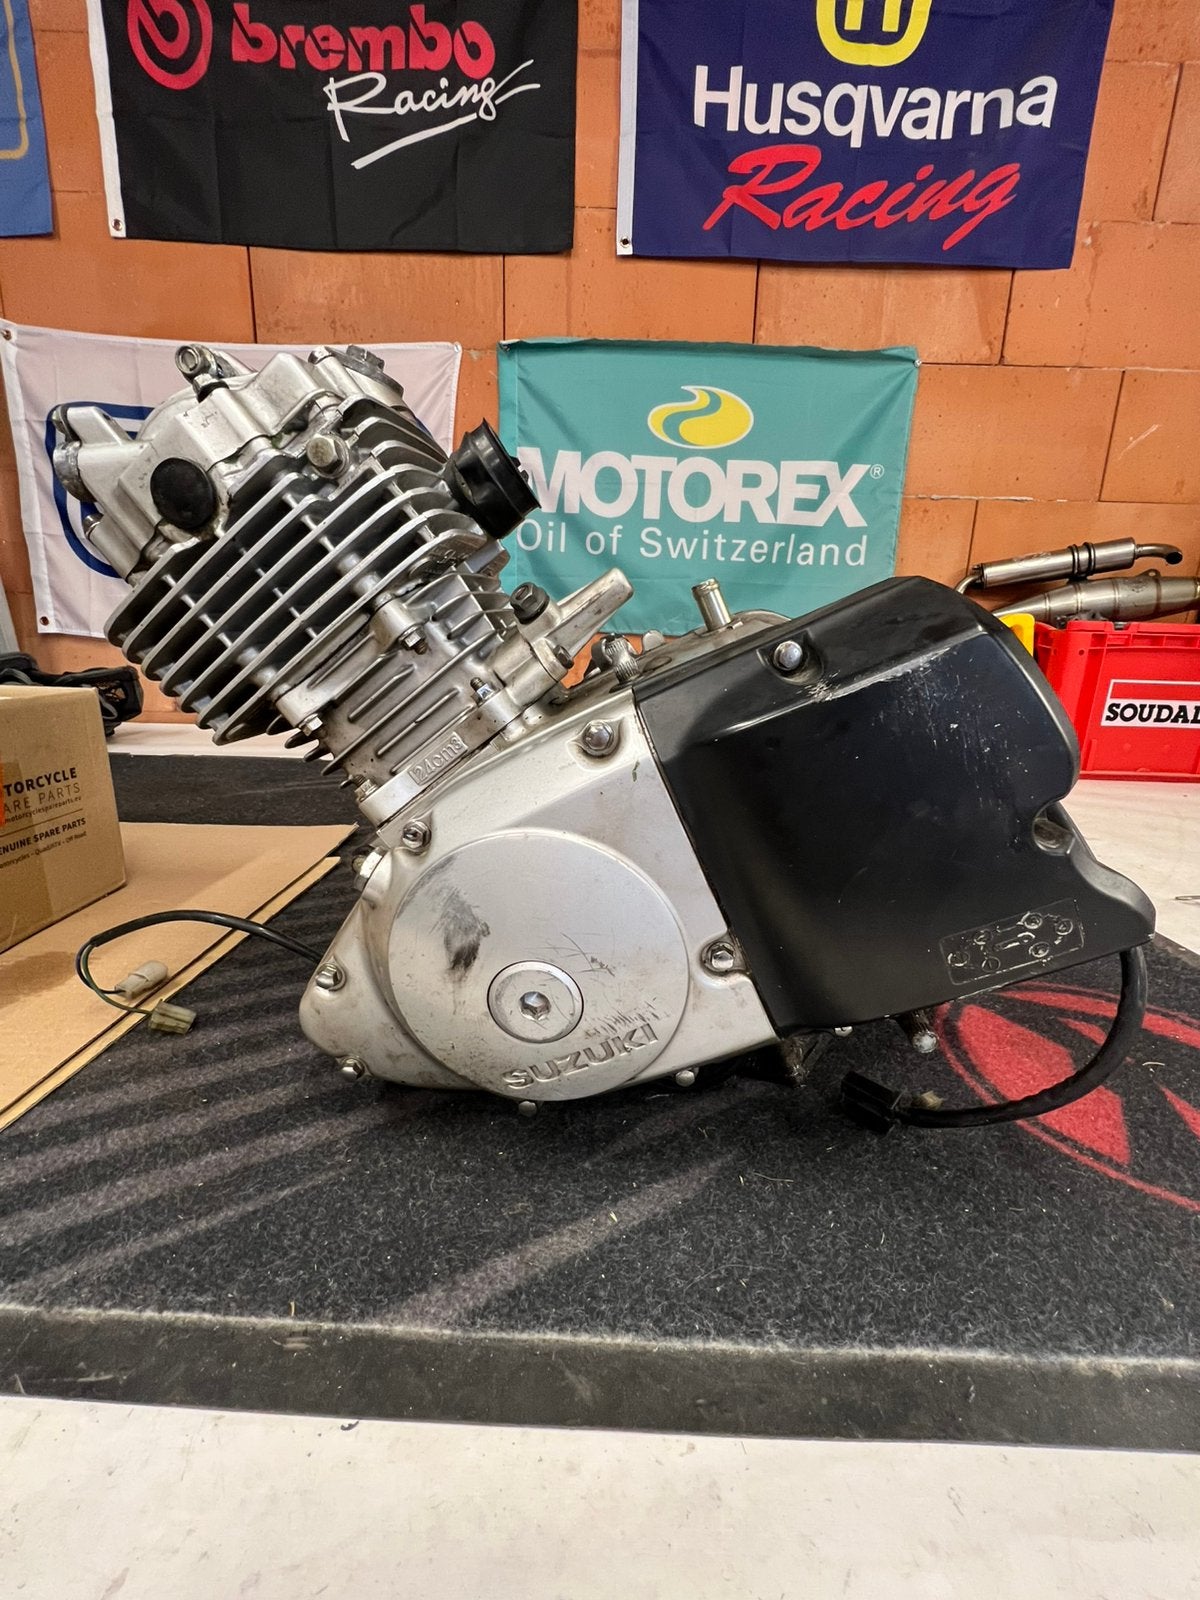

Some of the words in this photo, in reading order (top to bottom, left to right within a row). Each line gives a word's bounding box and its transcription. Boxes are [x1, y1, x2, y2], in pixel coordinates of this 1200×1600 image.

[232, 3, 496, 79] brembo
[323, 71, 541, 141] Racing
[694, 65, 1058, 148] Husqvarna
[703, 144, 1021, 250] Racing
[517, 519, 567, 553] Oil
[585, 525, 622, 556] of
[639, 527, 867, 567] Switzerland
[3, 767, 77, 797] TORCYCLE
[4, 797, 31, 814] ARE
[38, 782, 81, 804] PARTS
[33, 826, 61, 843] SPARE
[62, 817, 86, 832] PARTS
[502, 1023, 658, 1090] SUZUKI
